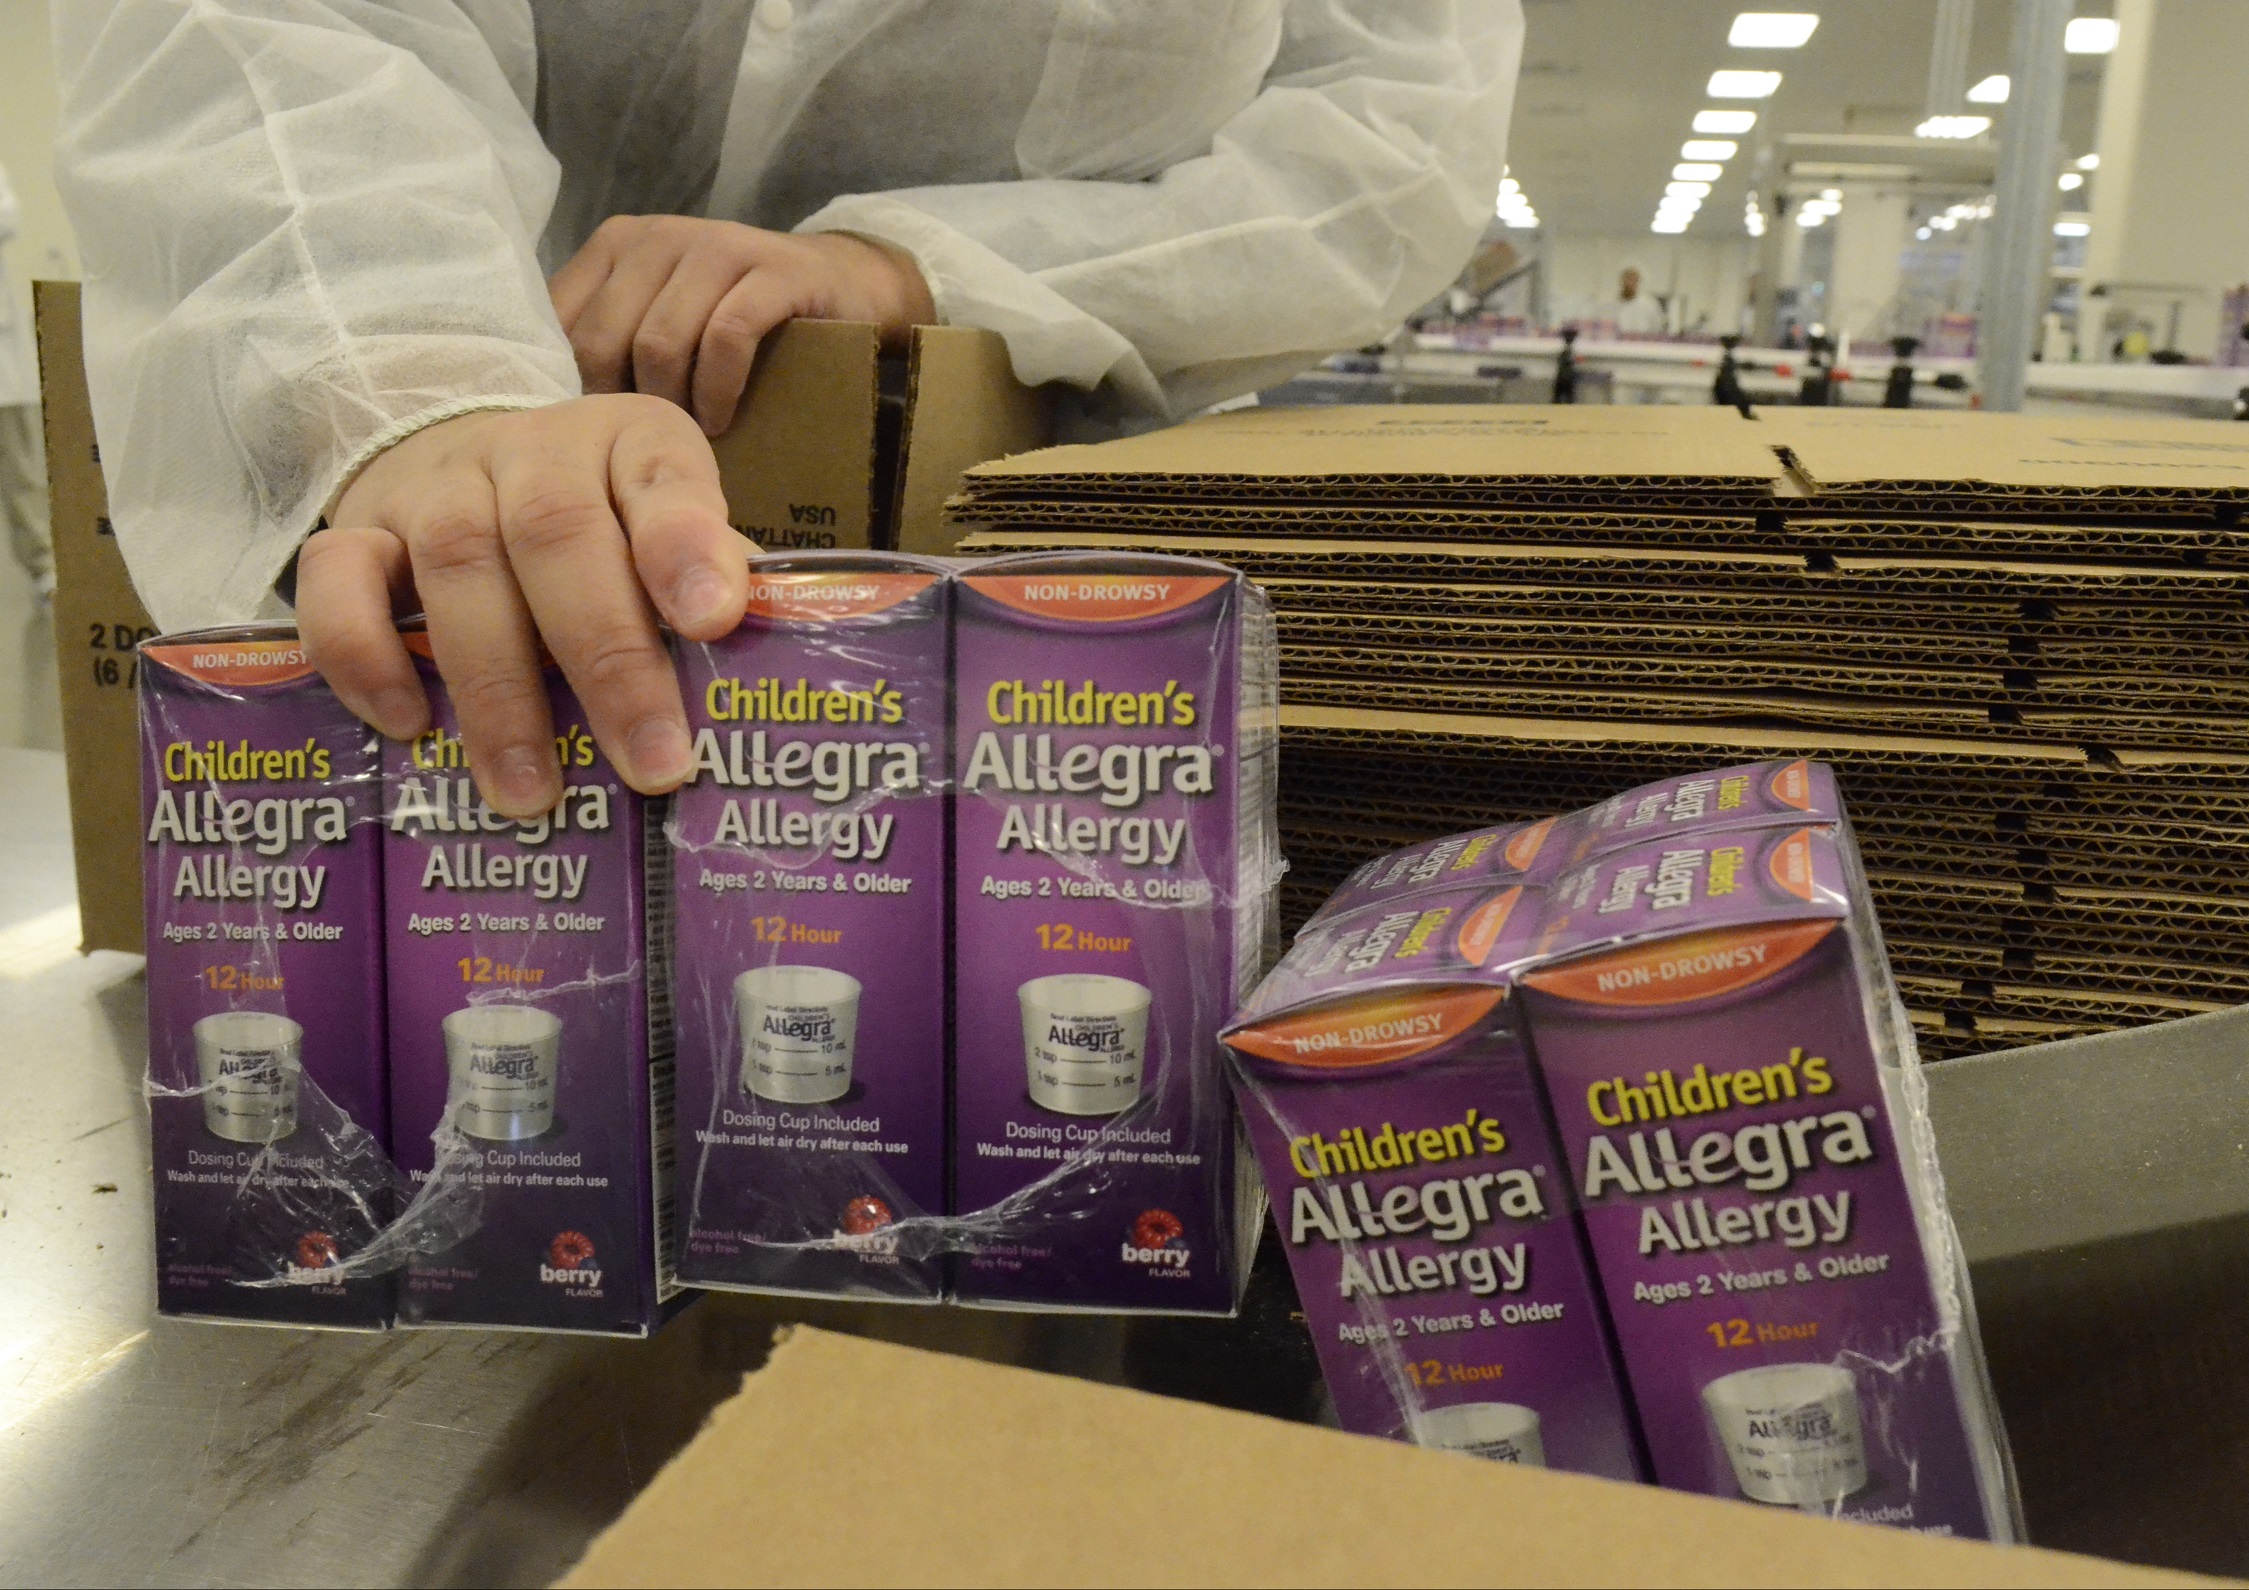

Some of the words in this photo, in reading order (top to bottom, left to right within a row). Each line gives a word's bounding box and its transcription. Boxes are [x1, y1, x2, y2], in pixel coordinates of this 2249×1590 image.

[790, 504, 836, 526] USA
[1024, 584, 1170, 601] NON-DROWSY
[90, 623, 106, 649] 2
[93, 657, 119, 687] (6
[193, 651, 307, 669] NON-DROWSY
[706, 678, 903, 723] Children's
[987, 679, 1195, 725] Children's
[164, 738, 331, 782] Children's
[684, 728, 919, 801] Allegra
[963, 731, 1213, 806] Allegra
[1625, 793, 1668, 828] Allergy
[1665, 779, 1716, 821] Allegra
[148, 790, 347, 855] Allegra
[715, 799, 893, 859] Allergy
[996, 804, 1185, 865] Allergy
[422, 843, 588, 898] Allergy
[1408, 839, 1468, 884] Allegra
[173, 854, 326, 908] Allergy
[700, 869, 747, 890] Ages
[754, 871, 765, 889] 2
[772, 871, 827, 891] Years
[833, 873, 848, 892] &
[854, 872, 912, 892] Older
[981, 876, 1032, 899] Ages
[1038, 877, 1051, 896] 2
[1058, 877, 1115, 897] Years
[1122, 879, 1137, 898] &
[1598, 865, 1650, 914] Allergy
[1644, 849, 1705, 910] Allegra
[163, 922, 202, 943] Ages
[207, 923, 217, 939] 2
[222, 923, 270, 940] Years
[275, 923, 288, 940] &
[293, 922, 343, 940] Older
[408, 914, 454, 935] Ages
[460, 913, 471, 931] 2
[478, 913, 529, 931] Years
[536, 914, 548, 931] &
[554, 913, 605, 931] Older
[752, 916, 787, 942] 12
[791, 924, 843, 944] Hour
[1036, 923, 1074, 950] 12
[1078, 931, 1133, 951] Hour
[1345, 910, 1420, 973] Allegra
[205, 965, 237, 989] 12
[240, 972, 285, 990] Hour
[458, 957, 492, 983] 12
[496, 964, 545, 983] Hour
[1597, 944, 1767, 992] NON-DROWSY
[763, 1015, 831, 1041] Allegra
[1048, 1025, 1119, 1051] Allegra
[1294, 1013, 1443, 1054] NON-DROWSY
[822, 1043, 832, 1053] 10
[1109, 1054, 1121, 1064] 10
[1587, 1047, 1833, 1127] Children's
[723, 1110, 775, 1130] Dosing
[780, 1112, 810, 1131] Cup
[814, 1115, 880, 1133] Included
[1006, 1121, 1061, 1142] Dosing
[1065, 1124, 1098, 1143] Cup
[1102, 1126, 1171, 1144] Included
[696, 1130, 730, 1144] Wash
[733, 1133, 756, 1146] and
[759, 1134, 774, 1147] let
[777, 1136, 793, 1148] air
[796, 1136, 817, 1151] dry
[820, 1137, 850, 1150] after
[853, 1140, 882, 1152] each
[886, 1142, 909, 1153] use
[977, 1142, 1013, 1157] Wash
[1016, 1146, 1040, 1158] and
[1043, 1148, 1061, 1160] let
[1108, 1150, 1138, 1163] after
[1142, 1152, 1173, 1164] each
[1176, 1154, 1200, 1165] use
[1289, 1108, 1506, 1179] Children's
[1585, 1109, 1872, 1197] Allegra
[188, 1151, 234, 1168] Dosing
[487, 1151, 515, 1168] Cup
[520, 1152, 581, 1167] Included
[168, 1170, 195, 1182] Wash
[198, 1173, 217, 1183] and
[220, 1173, 234, 1184] let
[469, 1173, 484, 1184] let
[486, 1174, 501, 1184] air
[504, 1174, 522, 1187] dry
[526, 1175, 553, 1185] after
[556, 1175, 584, 1186] each
[587, 1177, 608, 1187] use
[1291, 1168, 1544, 1244] Allegra
[1639, 1190, 1850, 1254] Allergy
[859, 1255, 899, 1264] FLAVOR
[1122, 1243, 1190, 1267] berry
[540, 1264, 602, 1287] berry
[1149, 1268, 1190, 1277] FLAVOR
[1340, 1243, 1526, 1297] Allergy
[1634, 1281, 1692, 1305] Ages
[1697, 1275, 1714, 1295] 2
[1717, 1270, 1788, 1291] Years
[1794, 1262, 1813, 1282] &
[1818, 1253, 1890, 1279] Older
[566, 1289, 603, 1298] FLAVOR
[1338, 1322, 1389, 1344] Ages
[1393, 1318, 1408, 1337] 2
[1411, 1315, 1474, 1334] Years
[1480, 1308, 1496, 1327] &
[1501, 1302, 1564, 1324] Older
[1706, 1318, 1754, 1348] 12
[1756, 1322, 1819, 1344] Hour
[1405, 1360, 1446, 1387] 12
[1449, 1363, 1504, 1383] Hour
